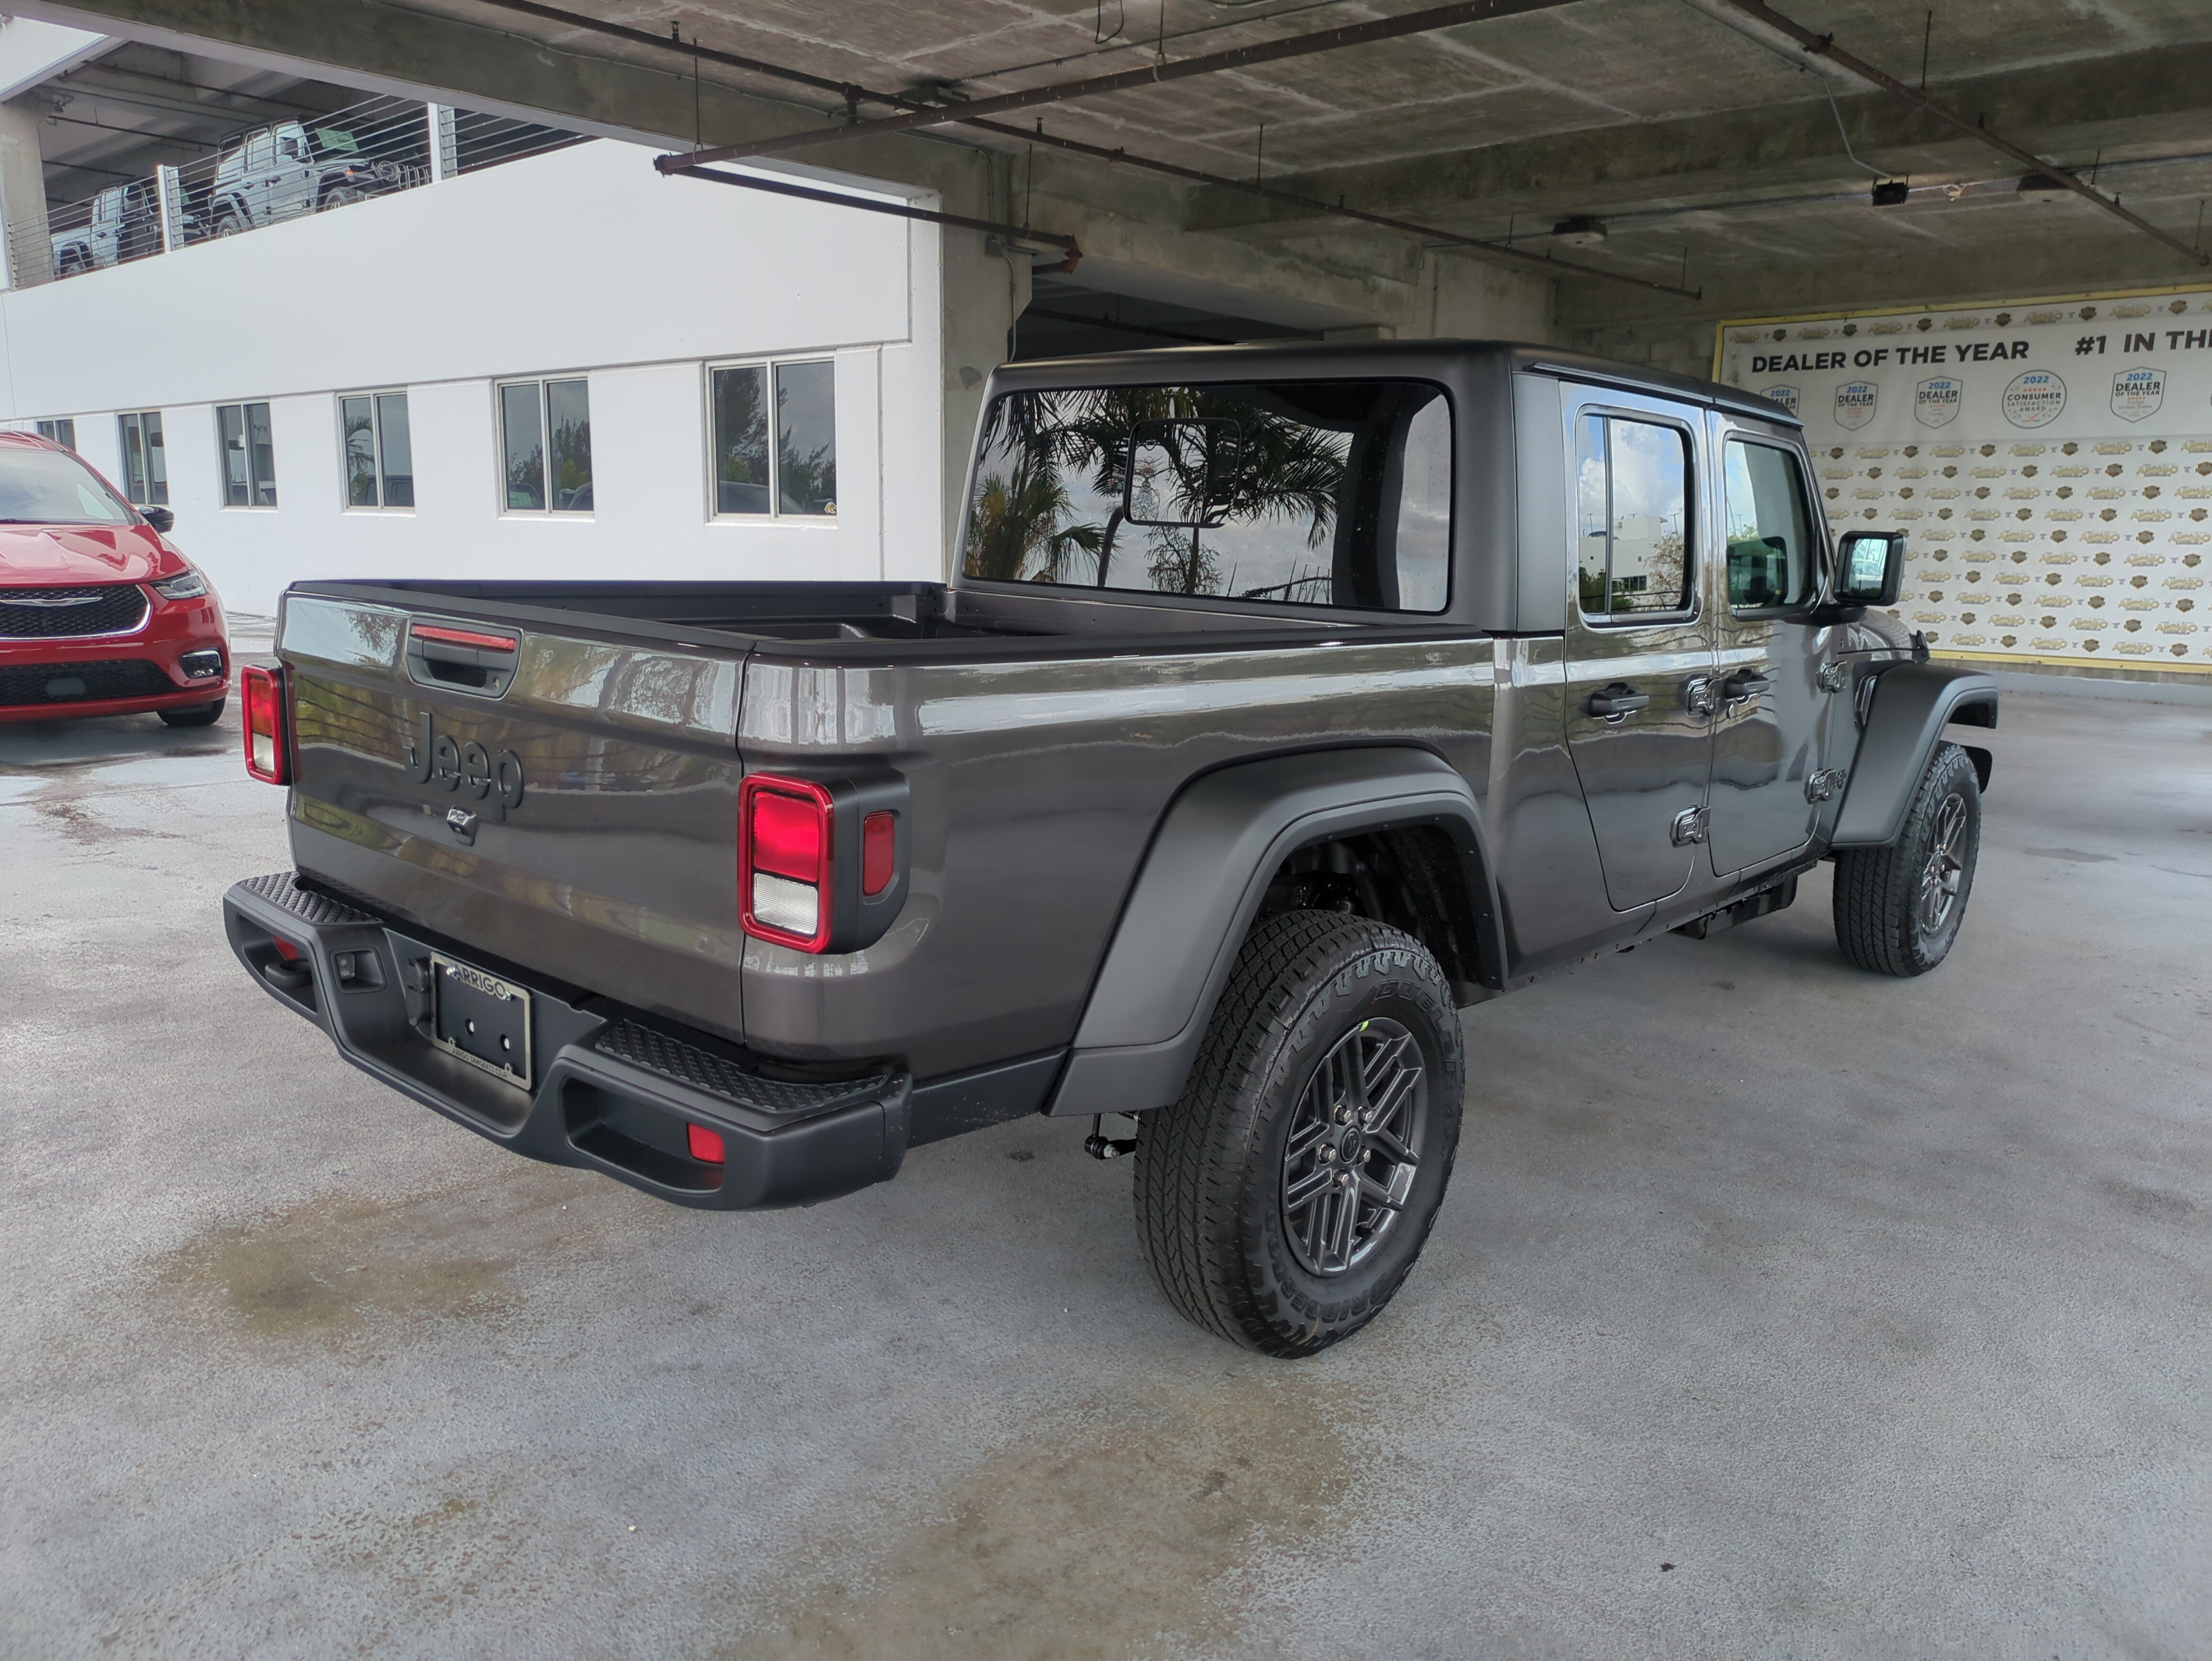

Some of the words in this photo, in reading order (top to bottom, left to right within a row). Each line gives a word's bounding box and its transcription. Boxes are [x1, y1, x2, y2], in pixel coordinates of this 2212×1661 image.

[2075, 335, 2107, 355] #1
[2124, 332, 2156, 353] IN
[2166, 329, 2212, 350] TH
[1752, 352, 1847, 373] DEALER
[1854, 349, 1889, 367] OF
[1896, 345, 1947, 365] THE
[1955, 341, 2029, 363] YEAR
[2024, 376, 2049, 384] 2022
[2127, 373, 2153, 381] 2022
[2116, 382, 2161, 391] DEALER
[1838, 394, 1874, 403] DEALER
[1919, 390, 1958, 399] DEALER
[2007, 393, 2061, 401] CONSUMER
[403, 711, 524, 822] Jeep
[453, 963, 507, 997] ARRIGO
[1374, 979, 1457, 1090] DUELER
